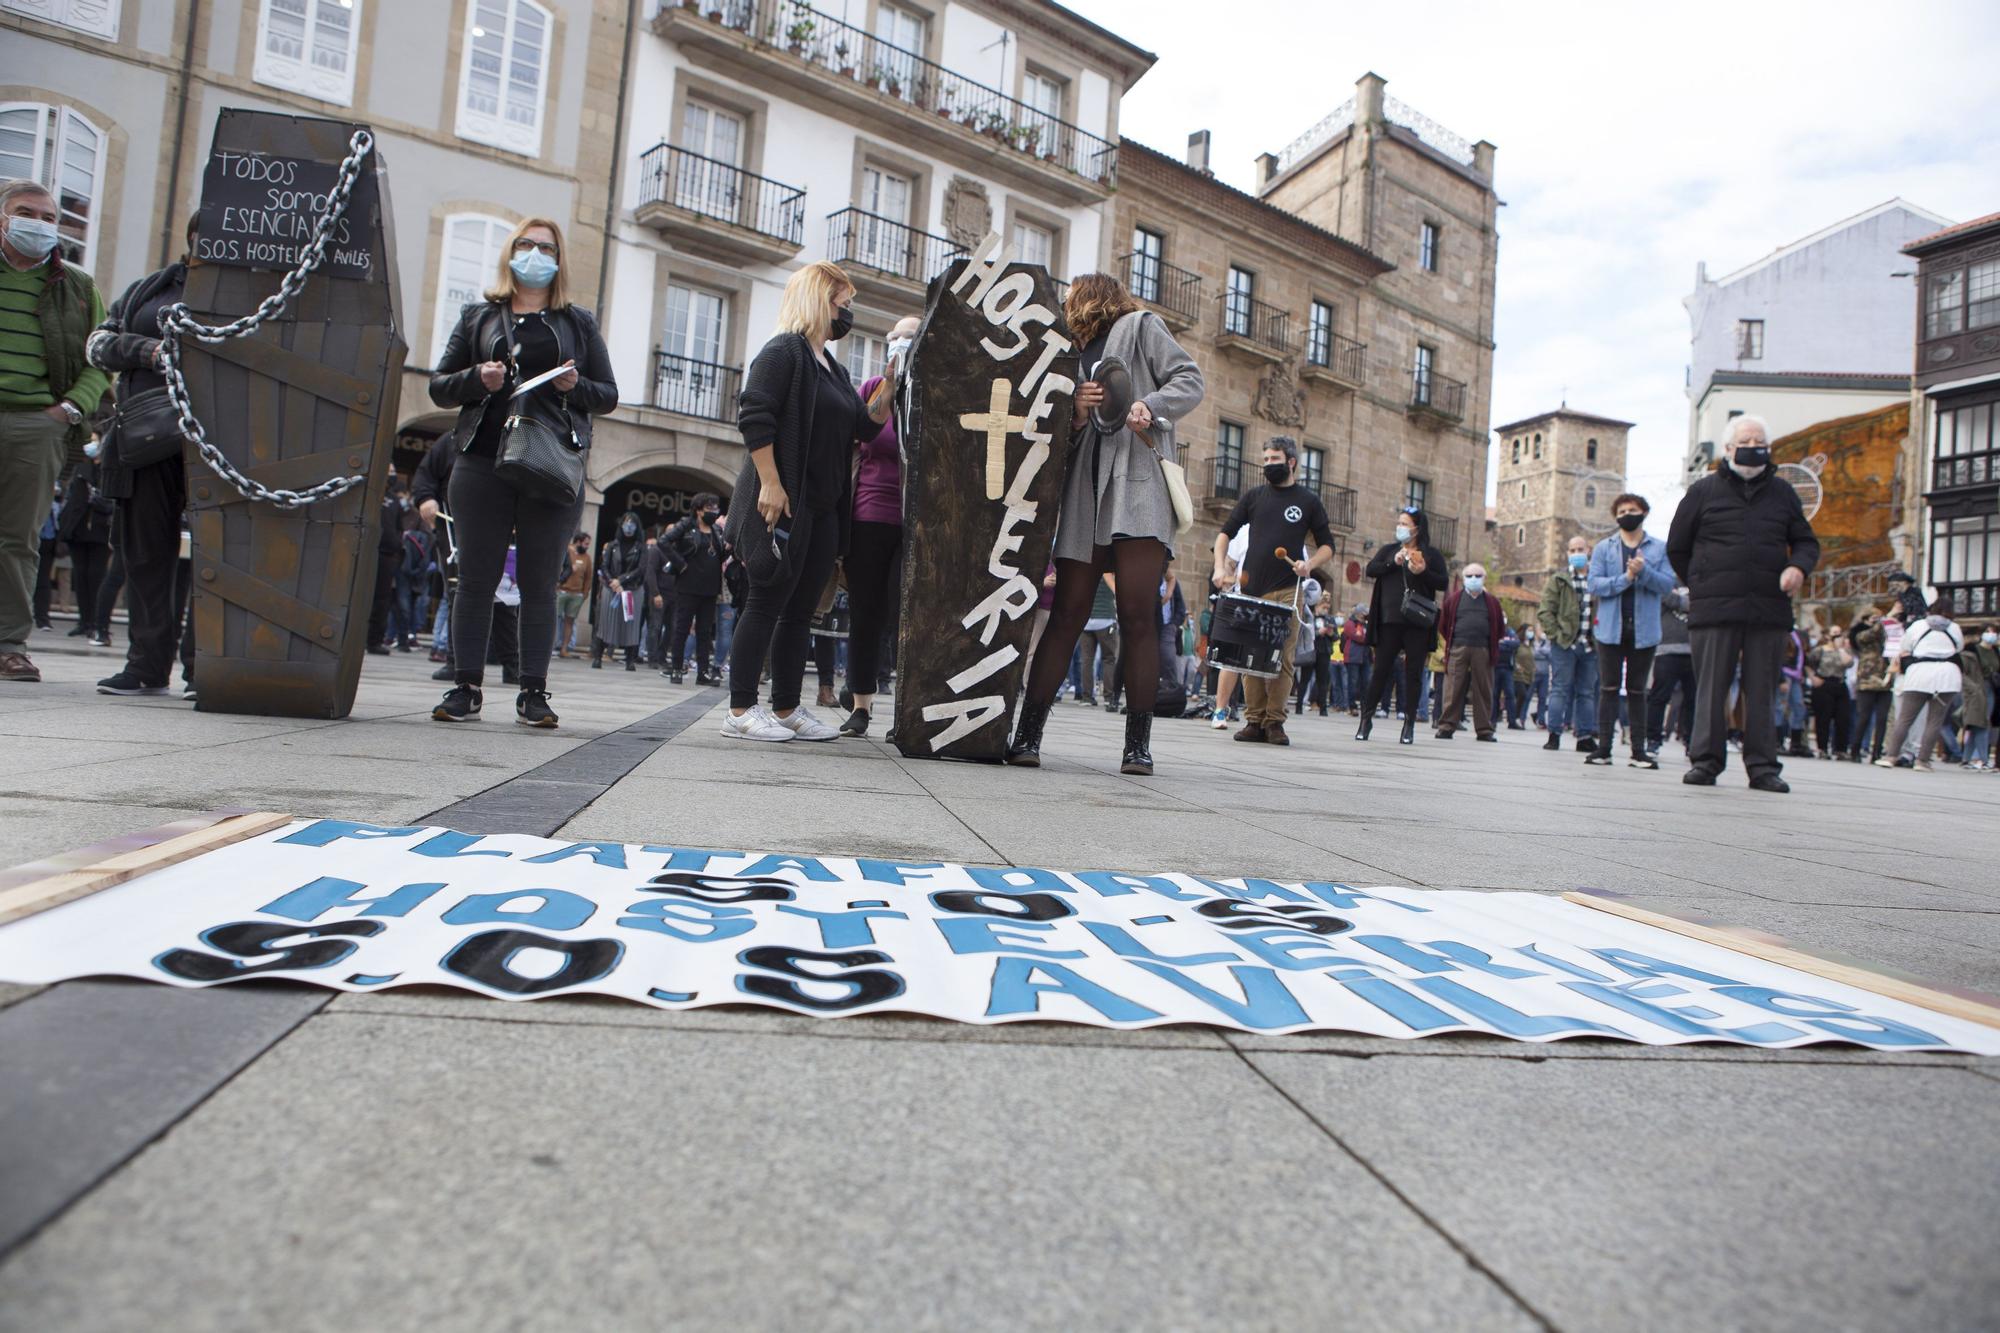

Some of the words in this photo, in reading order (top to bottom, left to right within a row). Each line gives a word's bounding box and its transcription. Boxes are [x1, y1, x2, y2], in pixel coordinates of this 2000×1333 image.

[214, 151, 299, 186] TODOS
[263, 188, 331, 213] SOMO
[222, 206, 350, 244] ESENCIALS
[626, 488, 693, 515] pepit
[273, 819, 1433, 912] PLATAFORMA
